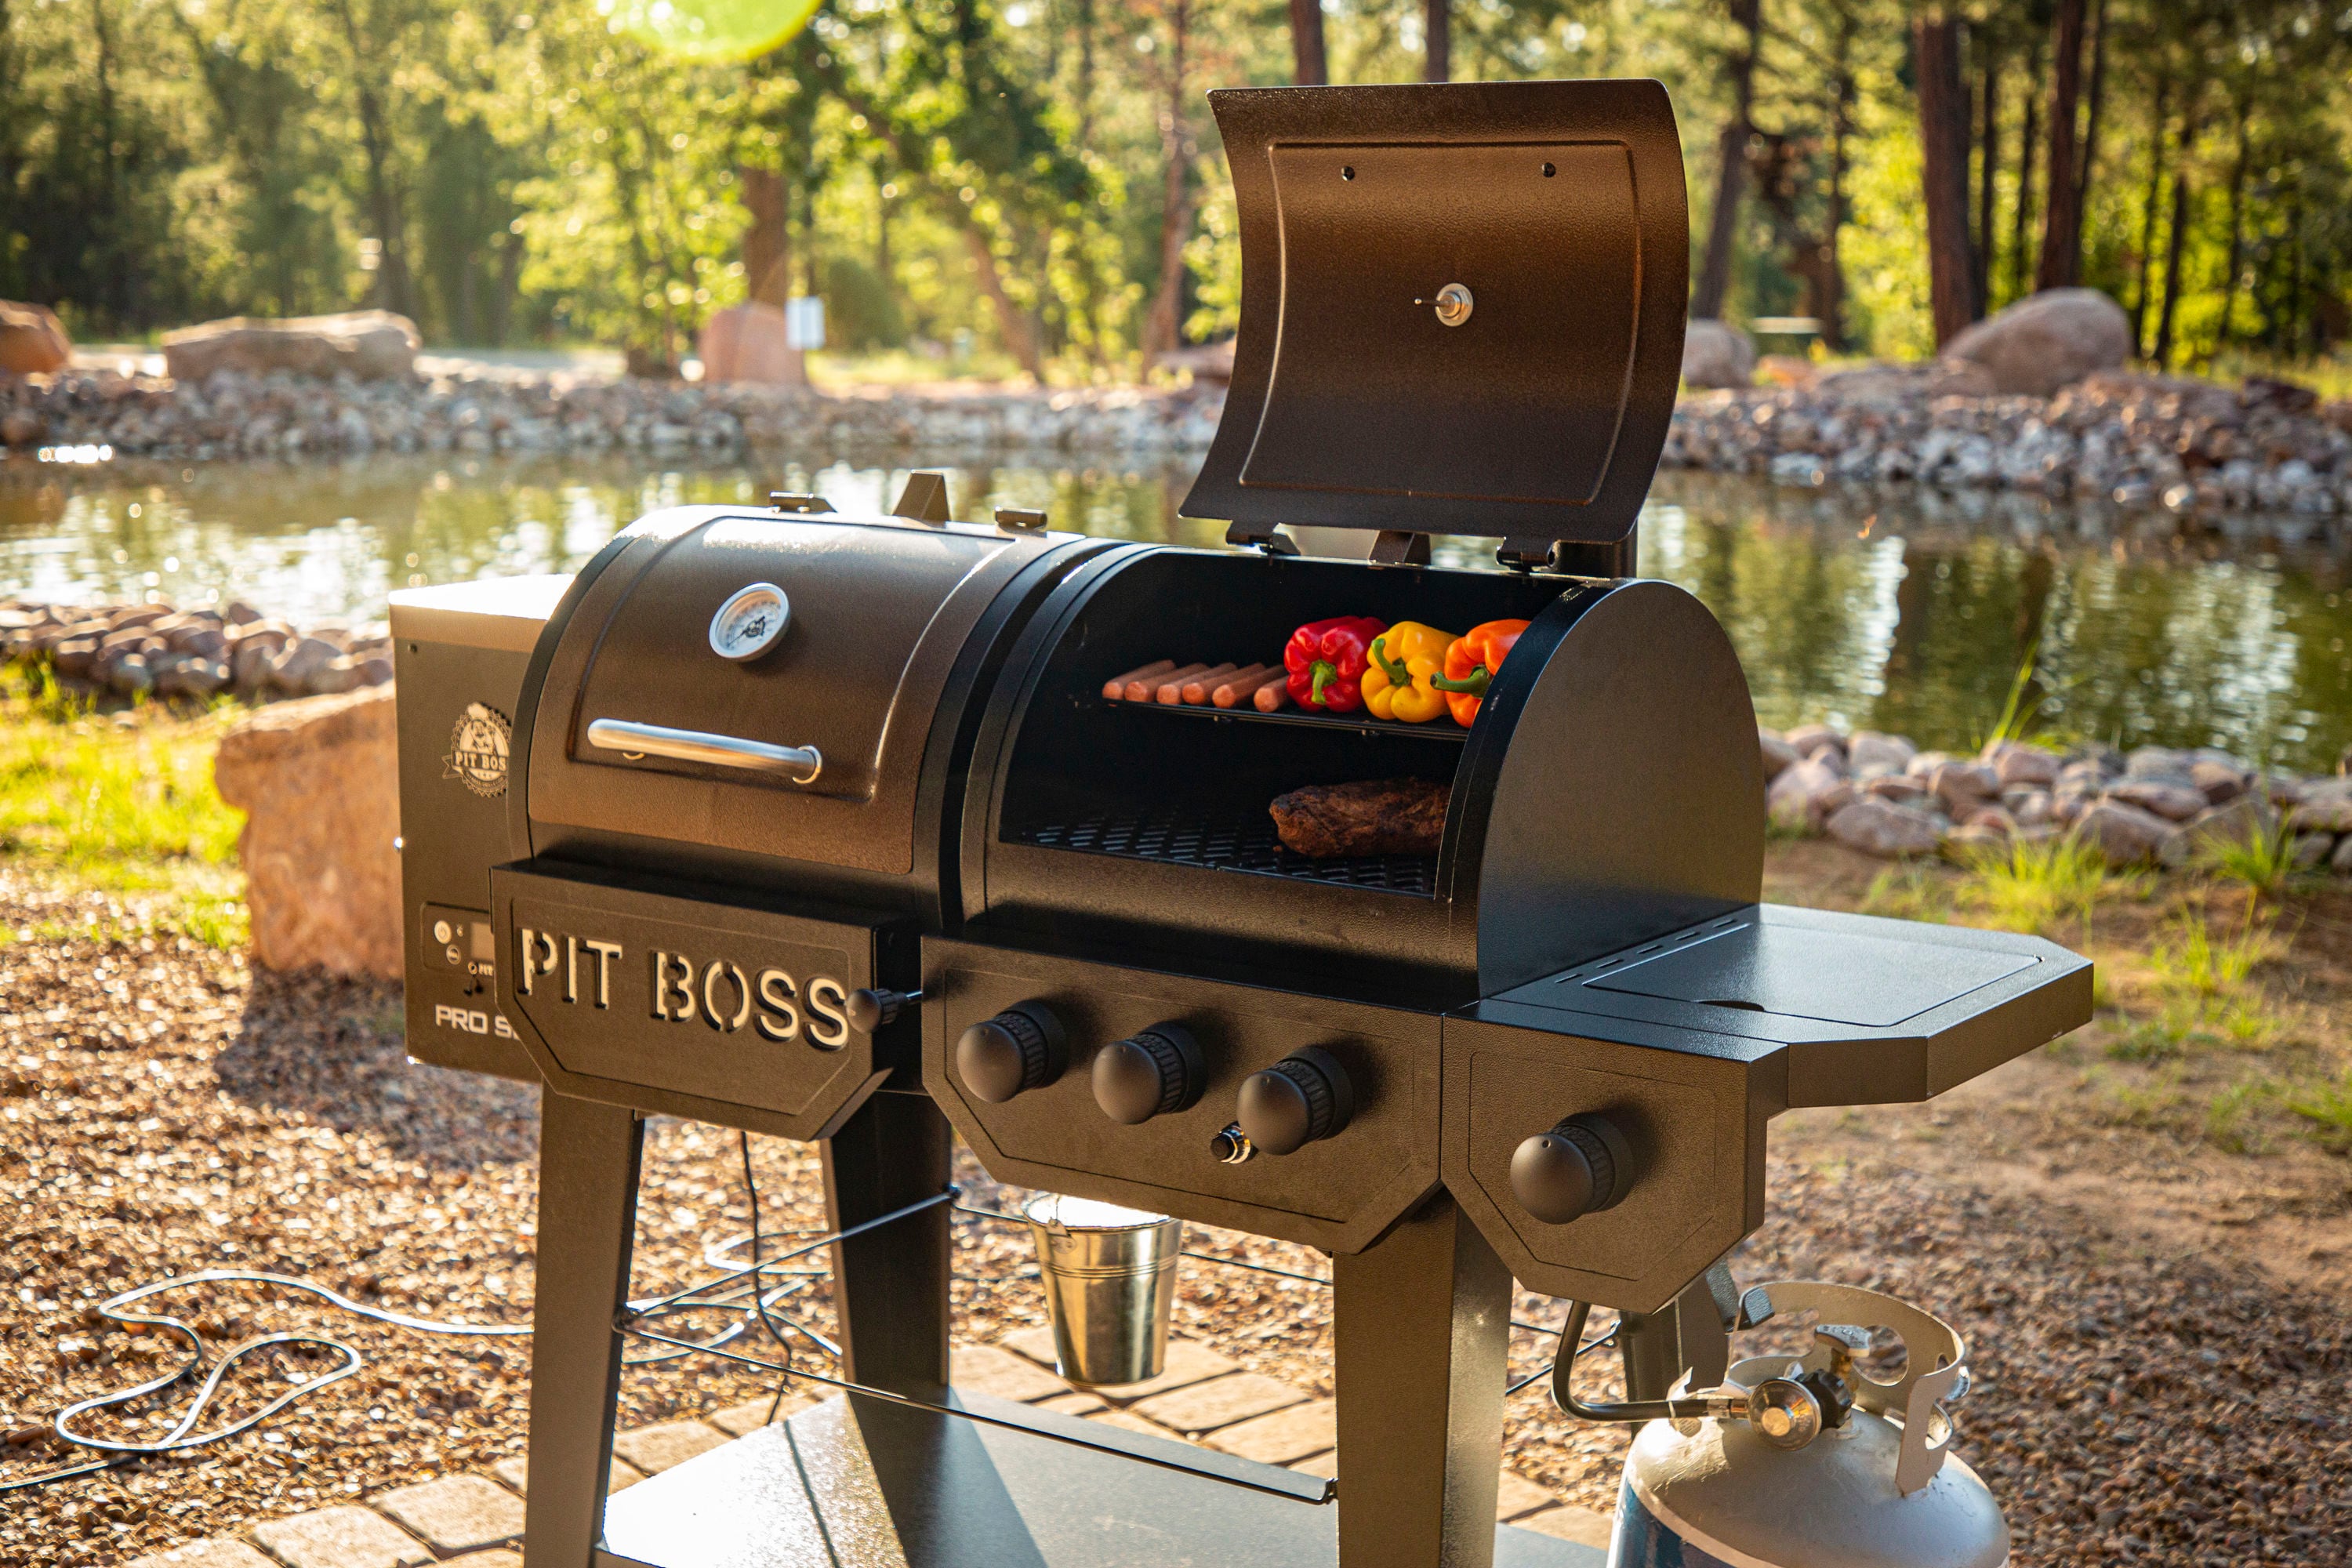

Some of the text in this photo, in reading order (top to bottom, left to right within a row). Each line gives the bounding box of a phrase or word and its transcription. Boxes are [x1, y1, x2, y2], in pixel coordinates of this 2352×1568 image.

[455, 751, 507, 771] PIT BOS
[517, 927, 850, 1051] PIT BOSS
[435, 1004, 520, 1041] PRO S
